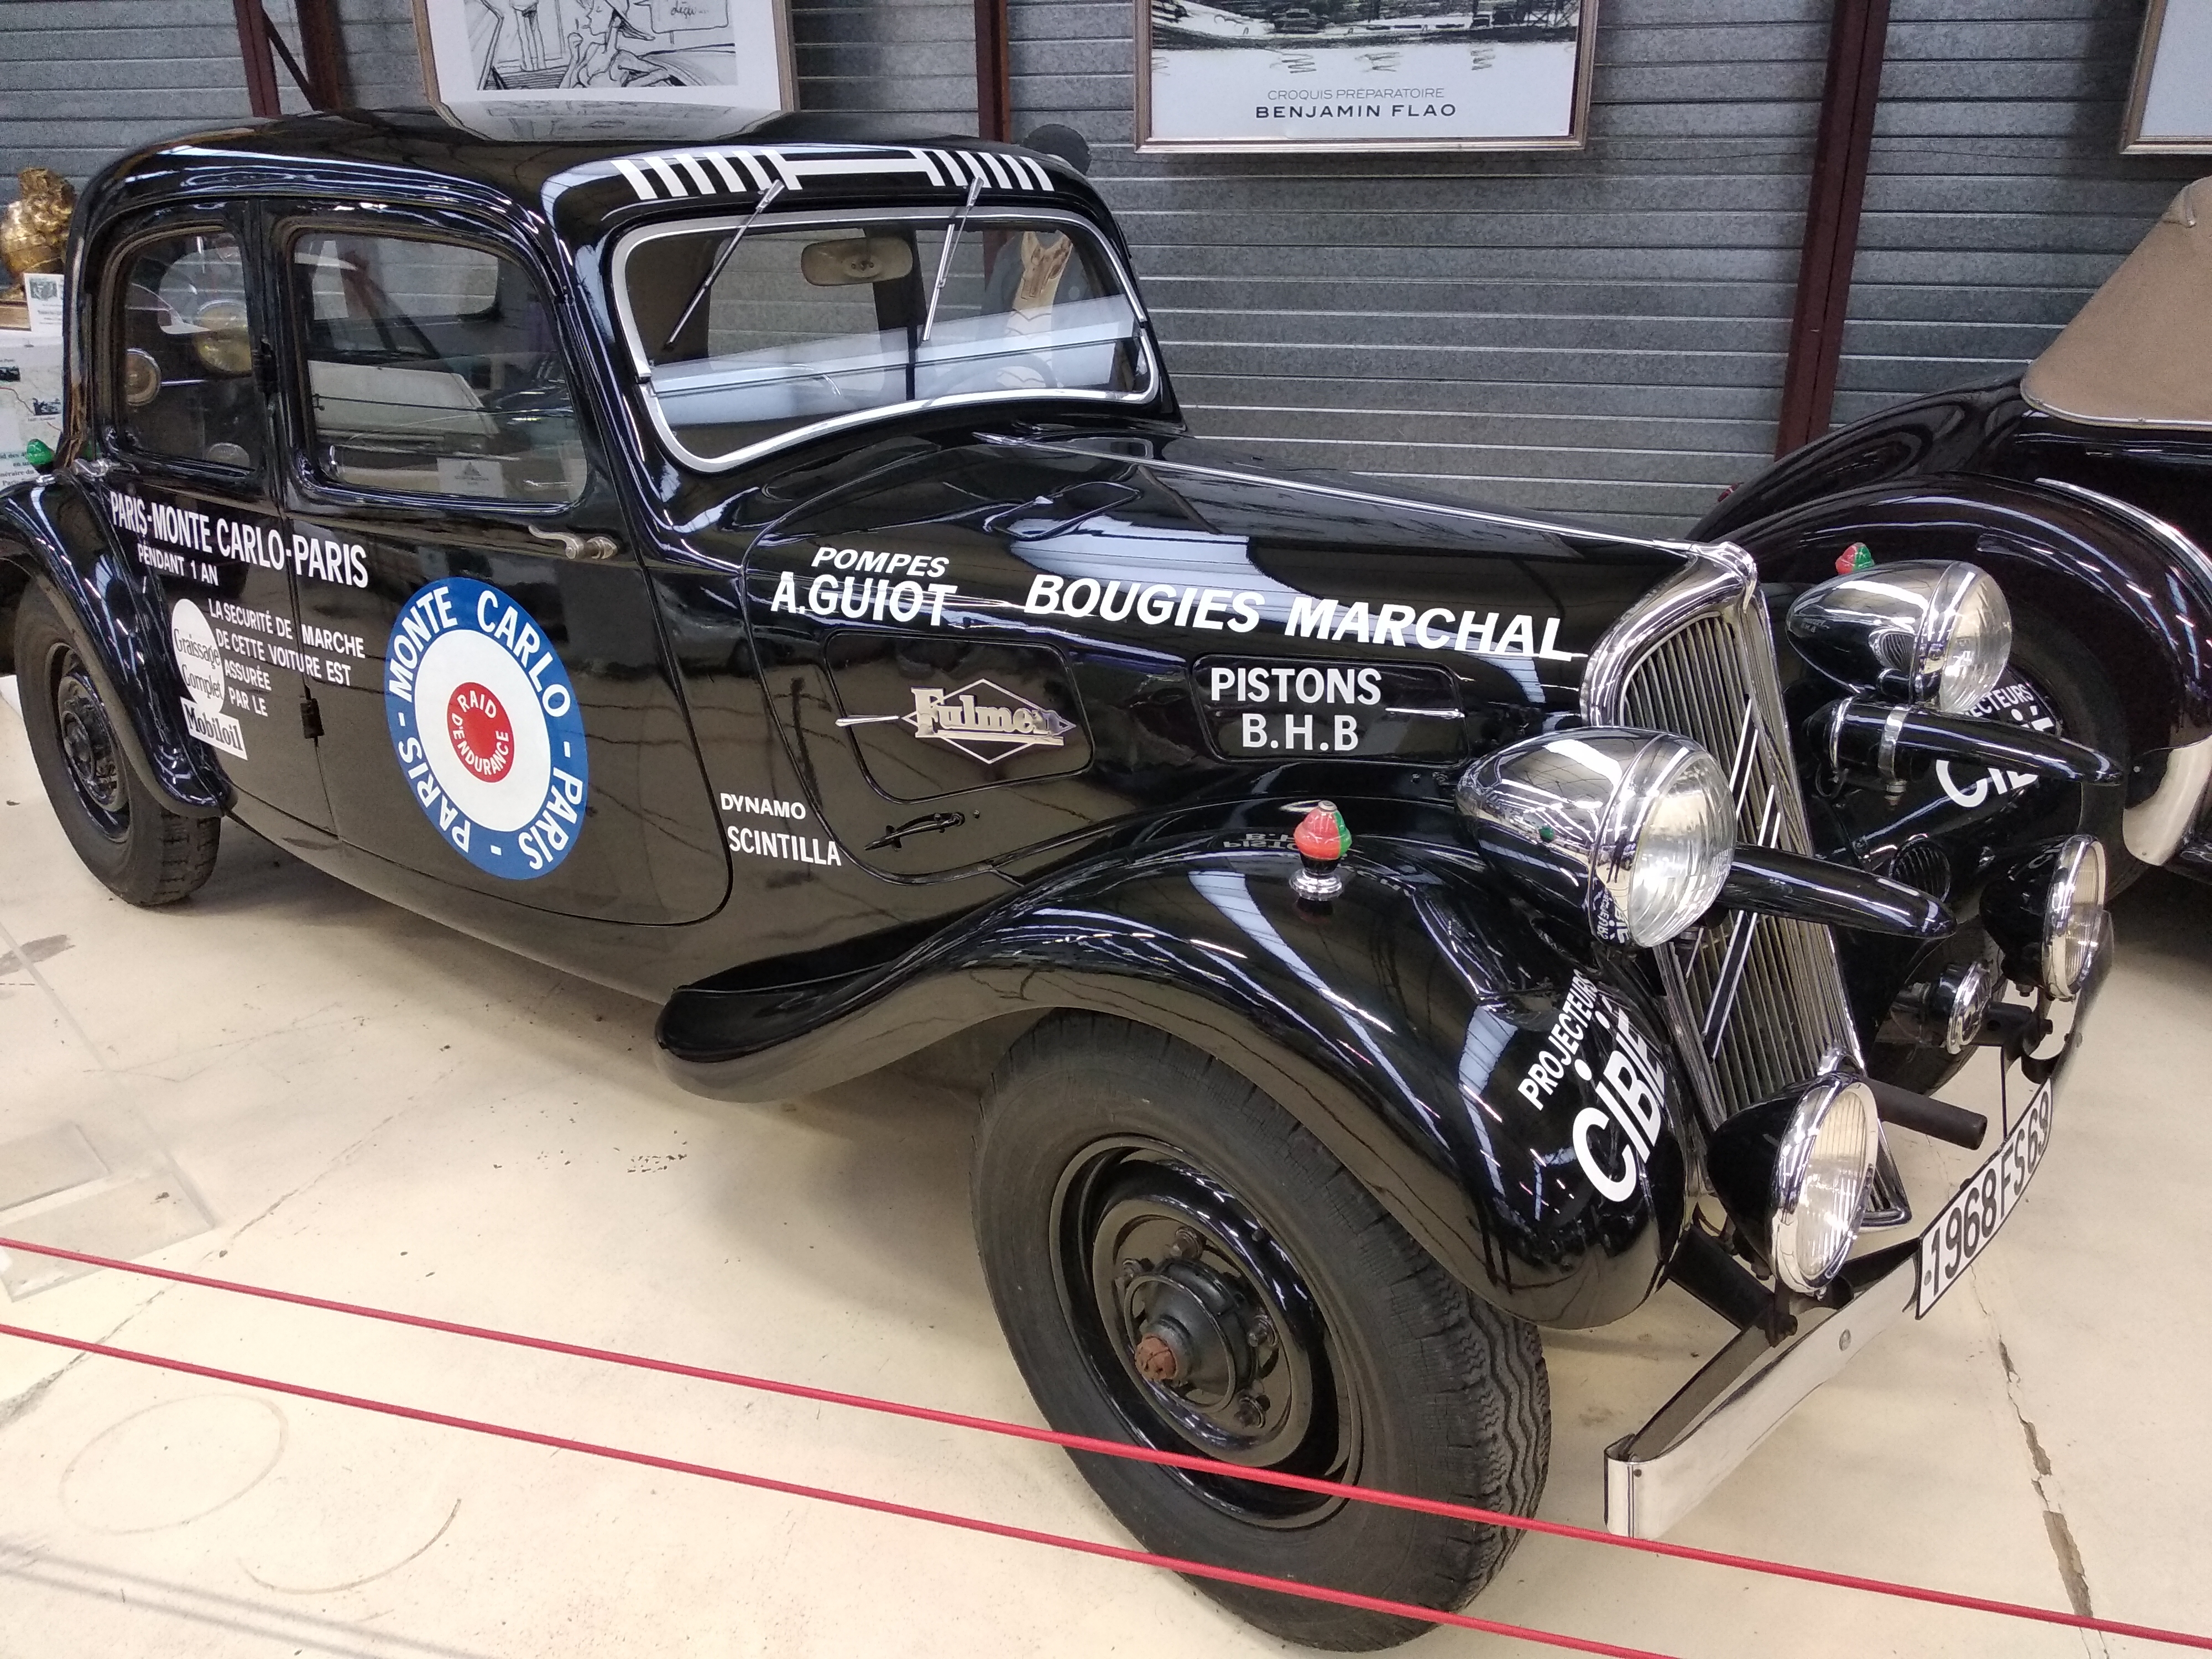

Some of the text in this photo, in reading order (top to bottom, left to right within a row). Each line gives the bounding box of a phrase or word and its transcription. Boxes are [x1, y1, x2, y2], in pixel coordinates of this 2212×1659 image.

[1255, 103, 1457, 118] BENJAMIN FLAO
[1267, 87, 1445, 101] CROQUIS PRÉPARATOIRE
[110, 491, 369, 588] PARIS-MONTE CARLO-PARIS
[137, 542, 219, 586] PENDANT 1 AN
[811, 546, 950, 578] POMPES
[770, 571, 958, 627] A.GUIOT
[1024, 573, 1574, 662] BOUGIES MARCHAL
[174, 628, 221, 670] Graissage
[208, 598, 224, 620] LA
[275, 616, 294, 640] DE
[301, 623, 366, 659] MARCHE
[215, 628, 352, 687] DE CETTE VOITURE EST
[223, 659, 272, 691] ASSURÉE
[181, 664, 223, 700] Complet
[228, 686, 269, 717] PAR LE
[1211, 666, 1382, 706] PISTONS
[1964, 683, 2034, 718] ECTEURS
[457, 690, 497, 718] RAID
[911, 687, 1060, 738] Fulmen
[184, 703, 244, 752] Mobiloil
[389, 586, 583, 870] PARIS MONTE CARLO PARIS
[1242, 713, 1359, 752] B.H.B
[720, 792, 806, 820] DYNAMO
[727, 825, 842, 867] SCINTILLA
[1517, 968, 1598, 1111] PROJECTEURS
